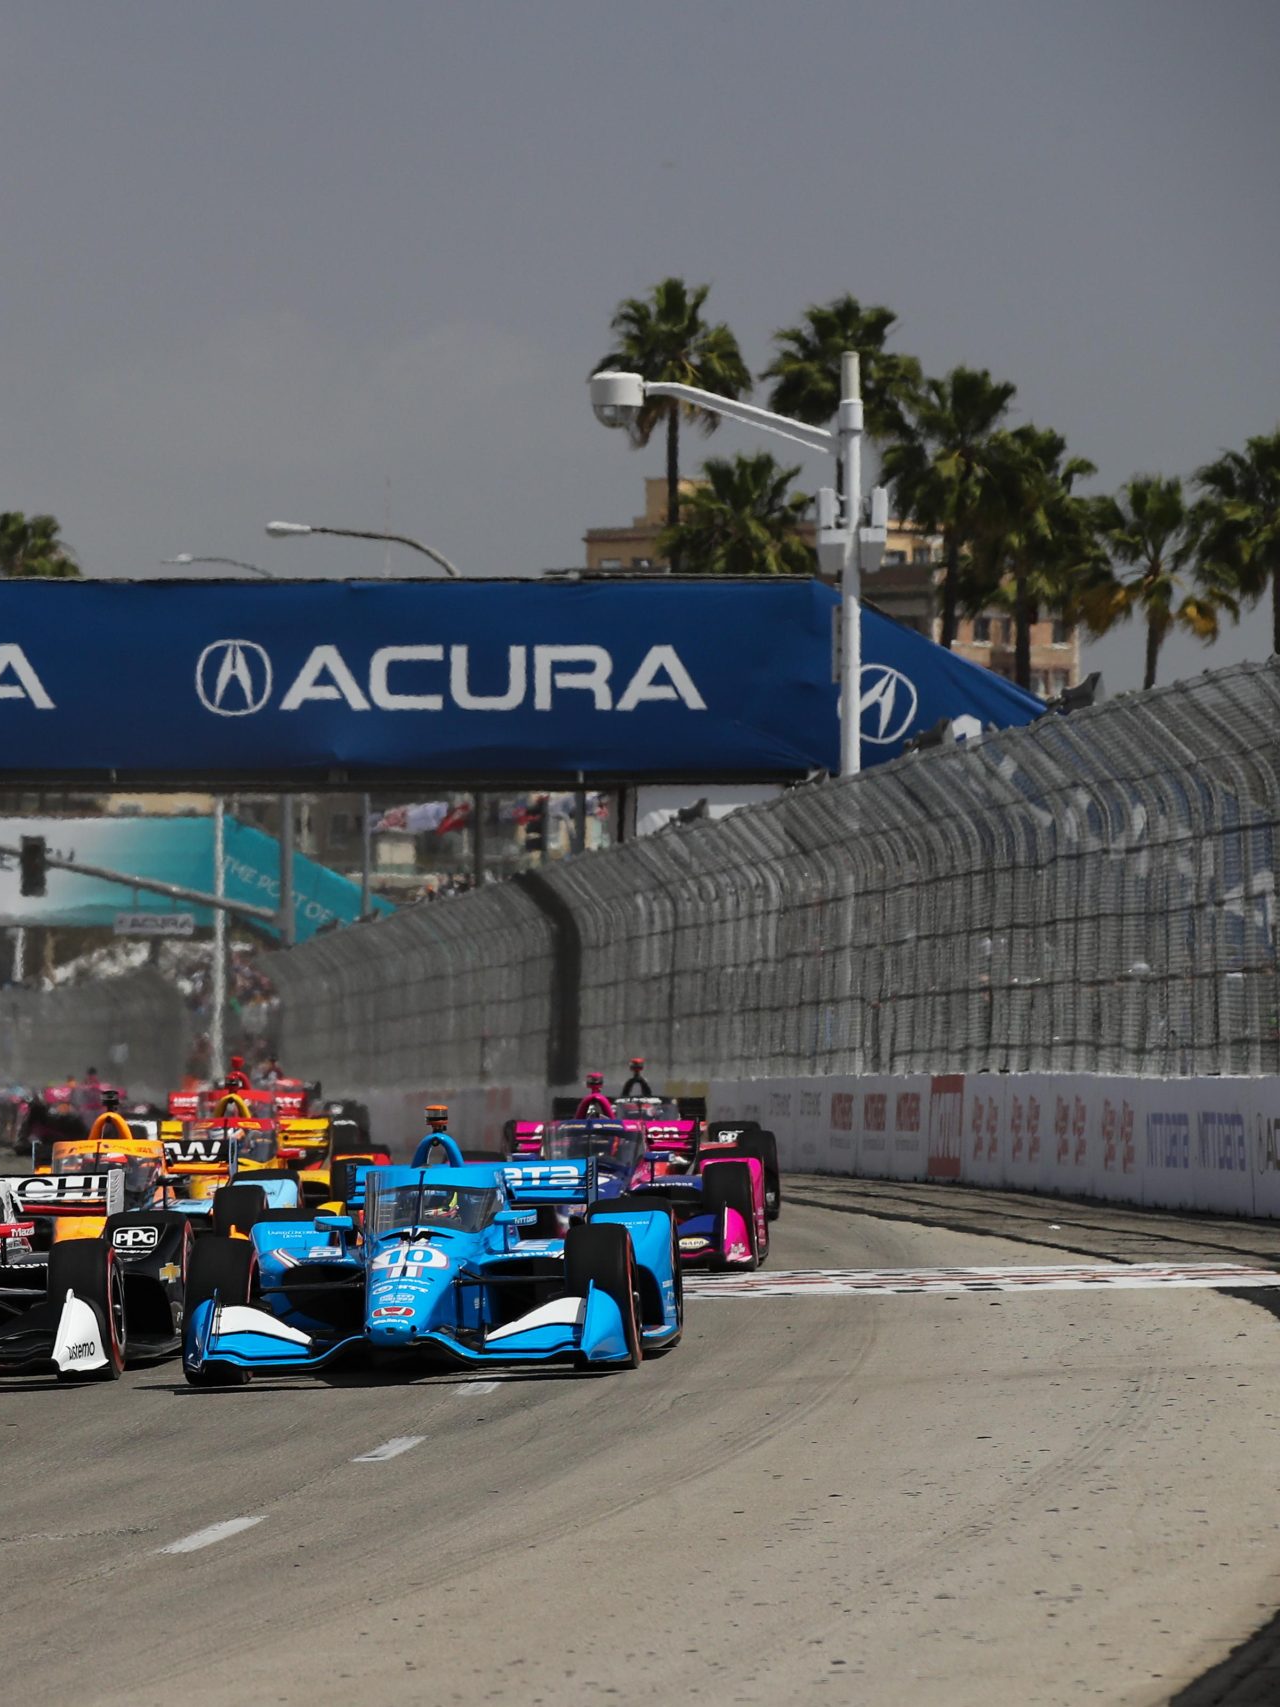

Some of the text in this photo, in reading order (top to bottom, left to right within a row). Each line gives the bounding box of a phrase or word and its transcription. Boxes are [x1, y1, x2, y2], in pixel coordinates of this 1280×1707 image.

[279, 644, 707, 711] ACURA
[115, 1229, 155, 1246] PPG
[387, 1249, 433, 1265] 10
